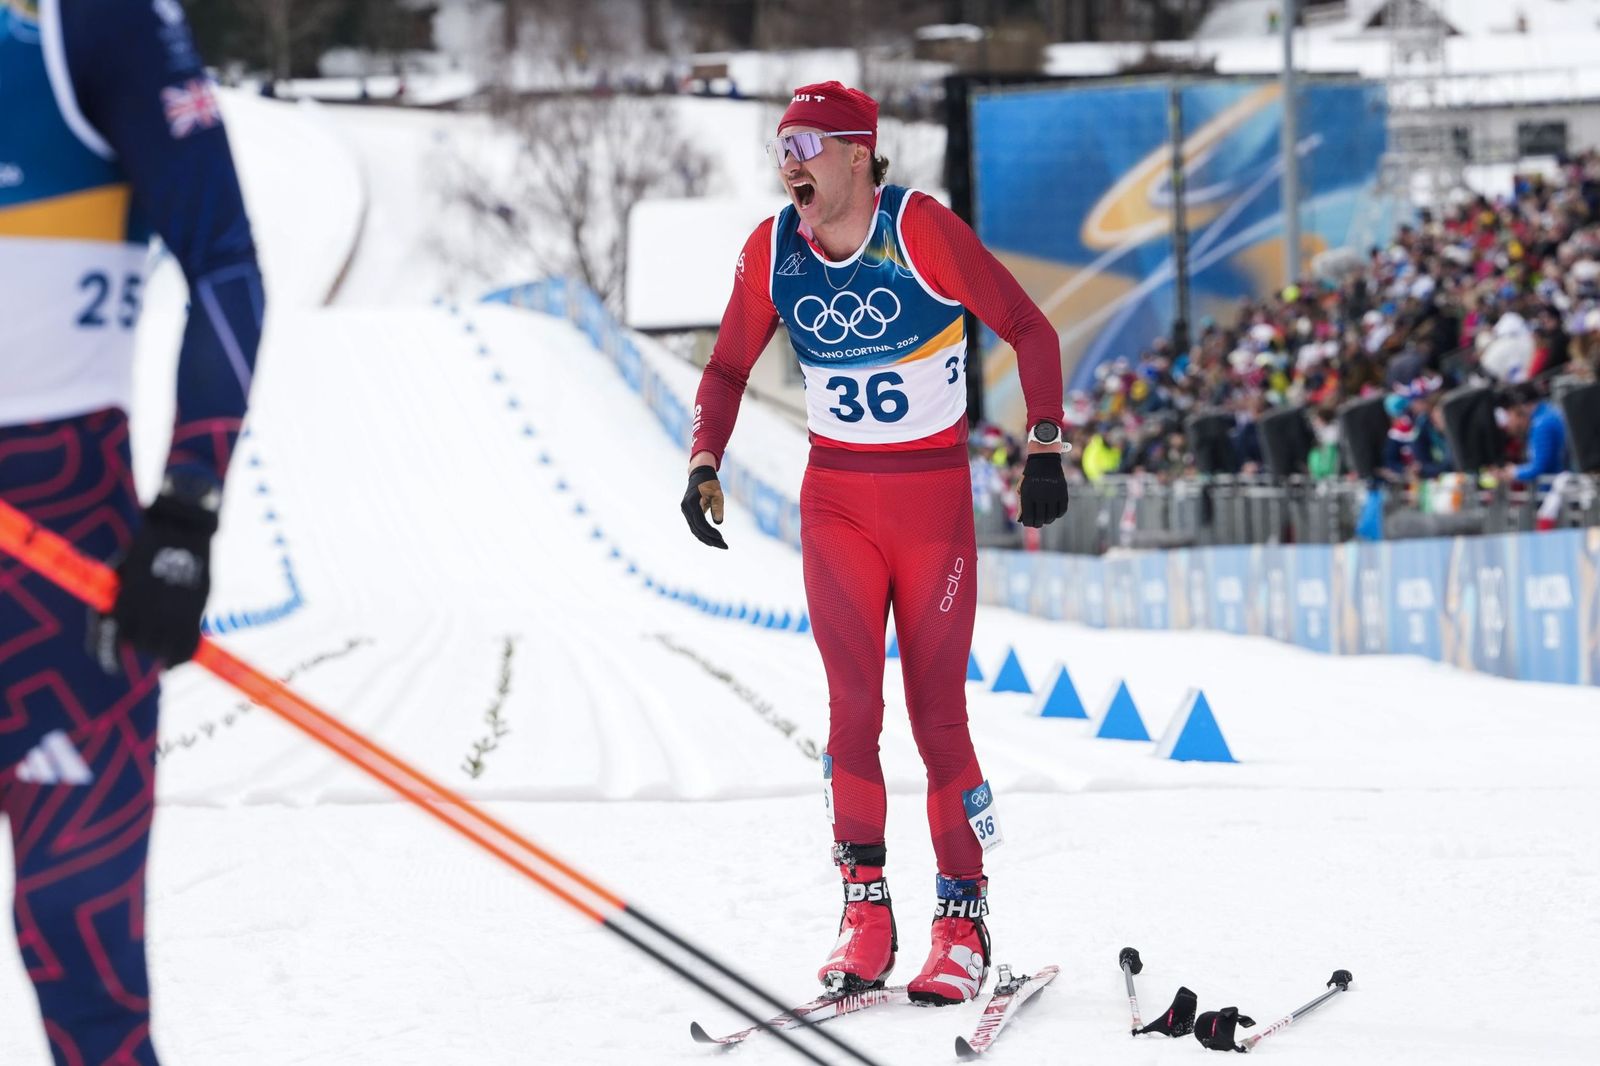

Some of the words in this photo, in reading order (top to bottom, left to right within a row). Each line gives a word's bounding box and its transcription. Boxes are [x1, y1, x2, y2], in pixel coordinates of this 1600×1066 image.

[76, 269, 142, 330] 25
[807, 348, 843, 359] LANO
[845, 345, 895, 357] CORTINA
[896, 334, 919, 349] 2026
[825, 371, 909, 423] 36
[940, 557, 964, 612] odlo
[975, 815, 995, 840] 36
